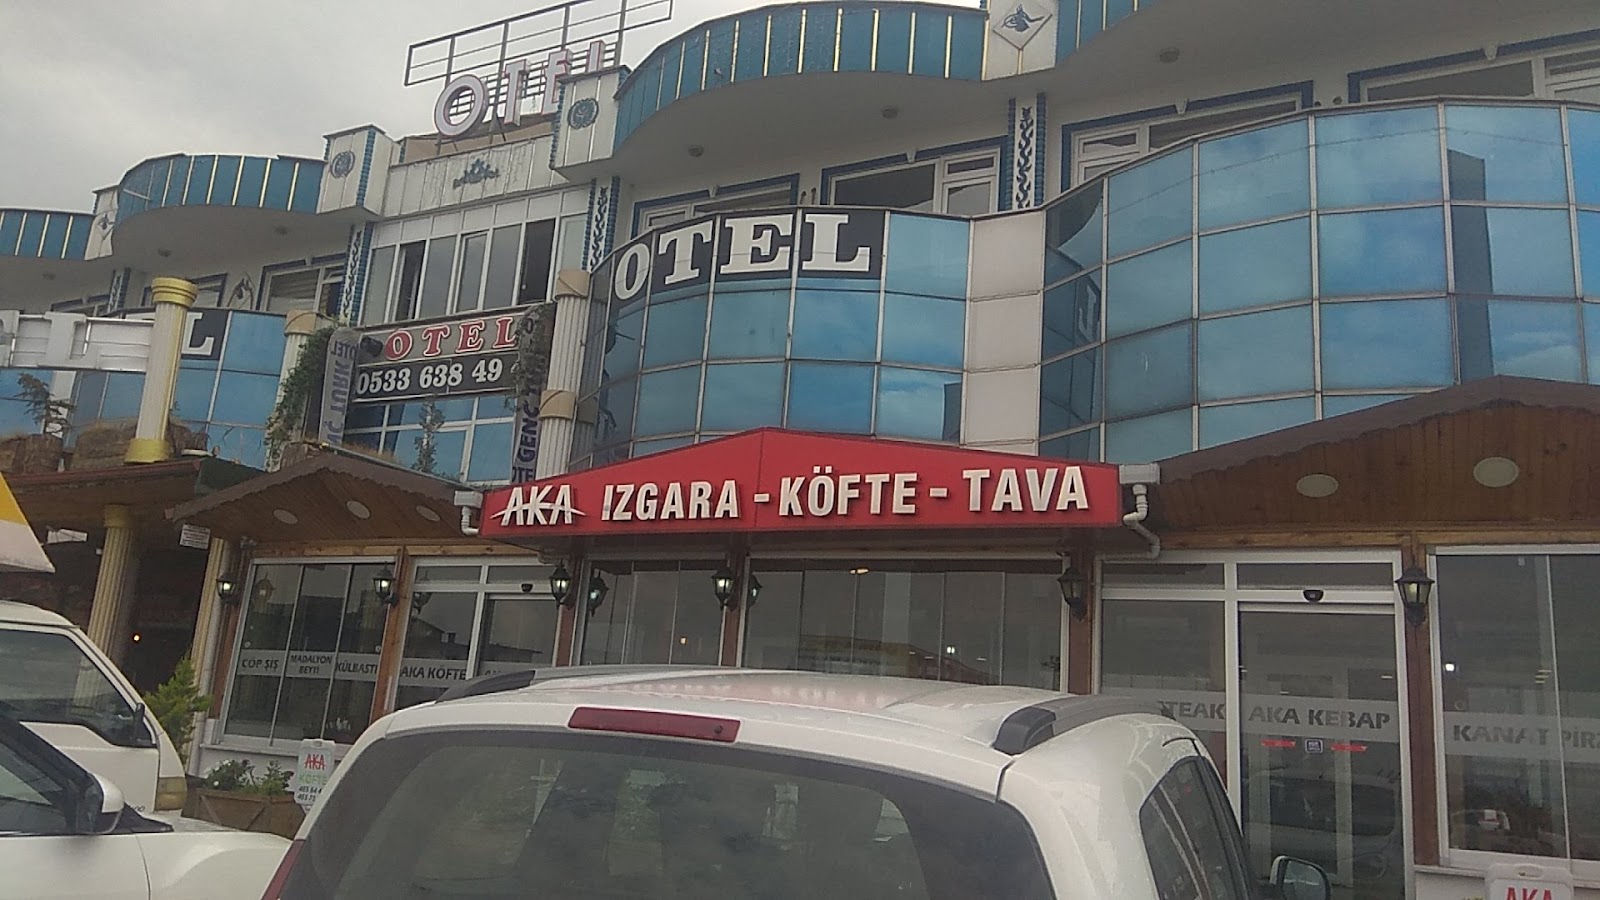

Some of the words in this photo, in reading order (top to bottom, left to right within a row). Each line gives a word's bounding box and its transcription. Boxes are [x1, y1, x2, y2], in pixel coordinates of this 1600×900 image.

[614, 213, 871, 300] OTEL
[384, 316, 518, 362] OTEL
[356, 367, 412, 395] 0533
[419, 362, 463, 389] 638
[471, 357, 503, 384] 49
[494, 484, 580, 527] AKA
[601, 479, 740, 521] IZGARA
[778, 465, 918, 517] KÖFTE
[962, 465, 1089, 512] TAVA
[290, 655, 333, 664] MADALYON
[400, 665, 425, 678] AKA
[1248, 705, 1300, 725] AKA
[1308, 708, 1391, 729] KEBAP
[1561, 726, 1600, 749] PİR
[304, 753, 327, 770] AKA
